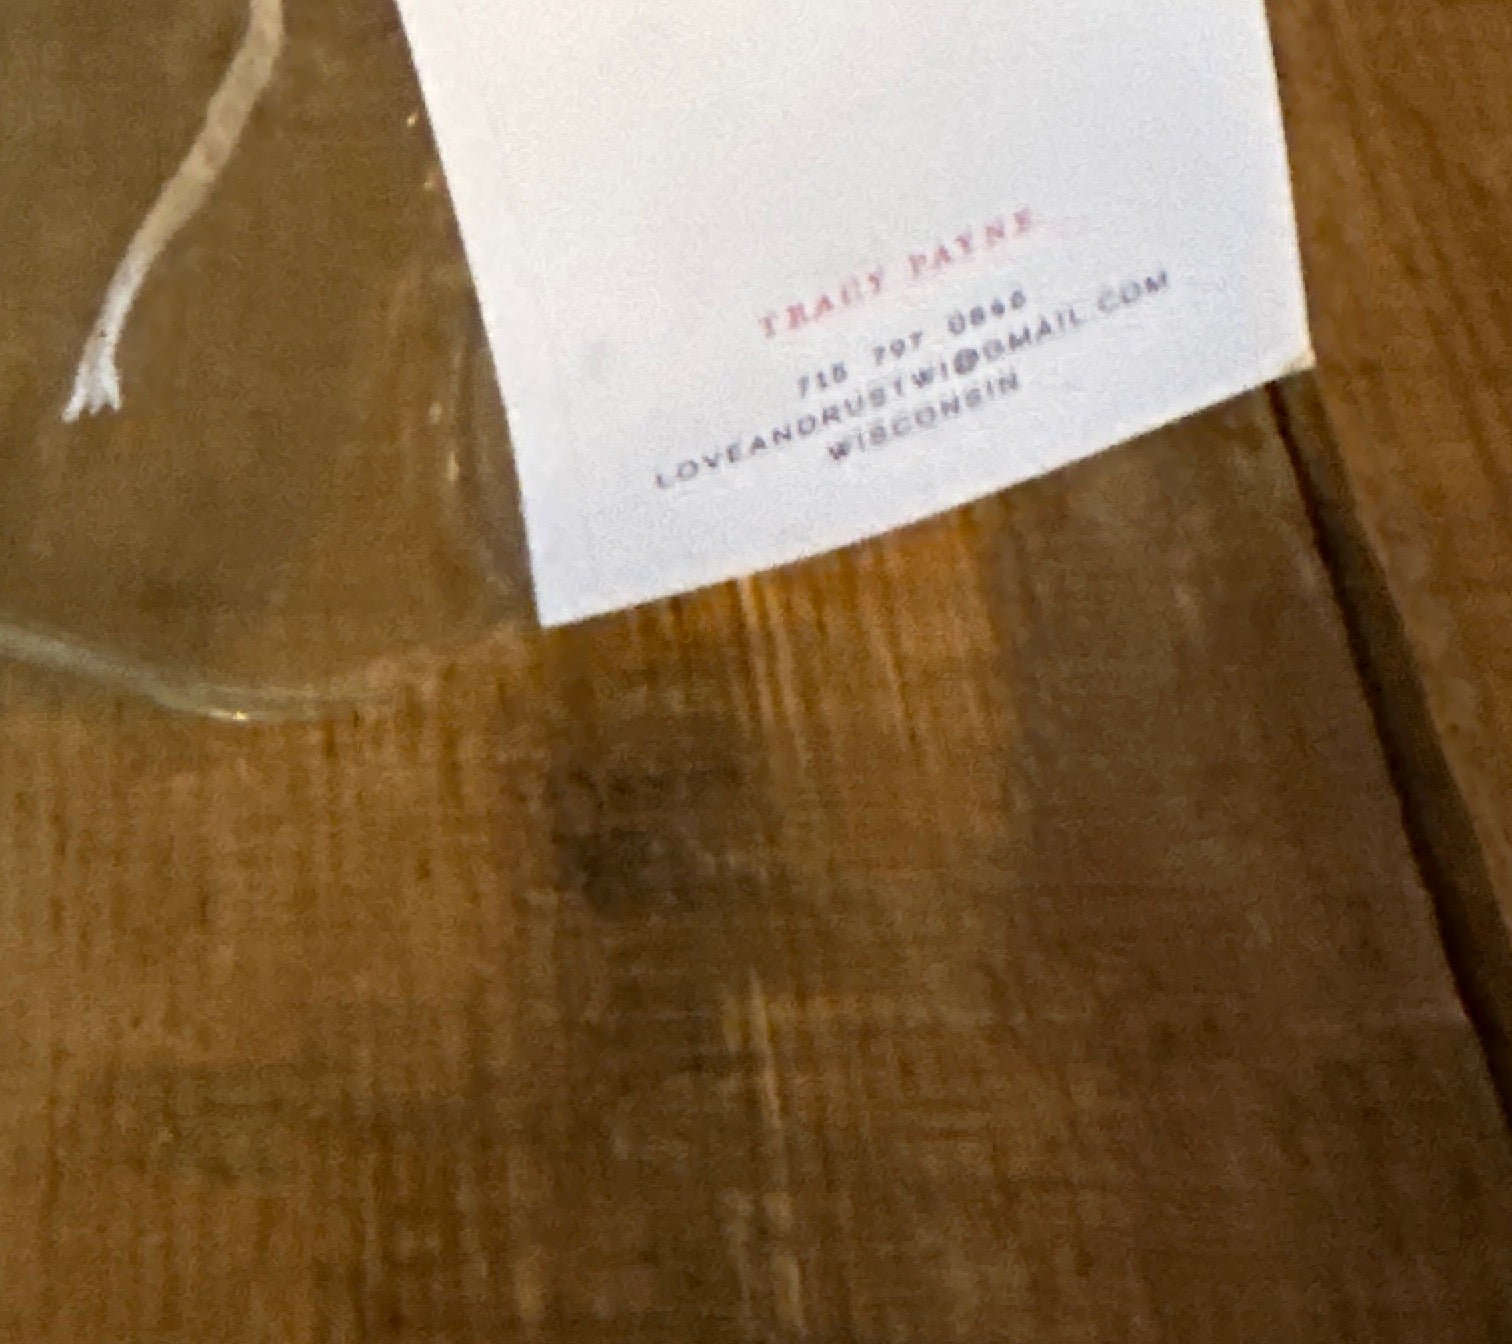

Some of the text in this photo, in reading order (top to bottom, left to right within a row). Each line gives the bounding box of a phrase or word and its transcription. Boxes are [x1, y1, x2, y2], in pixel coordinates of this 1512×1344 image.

[758, 207, 1034, 339] TRACY PAYNE
[654, 268, 1170, 490] LOVEANDRUSTWI@GMAILCOM
[826, 372, 1021, 463] WISCONSIN
